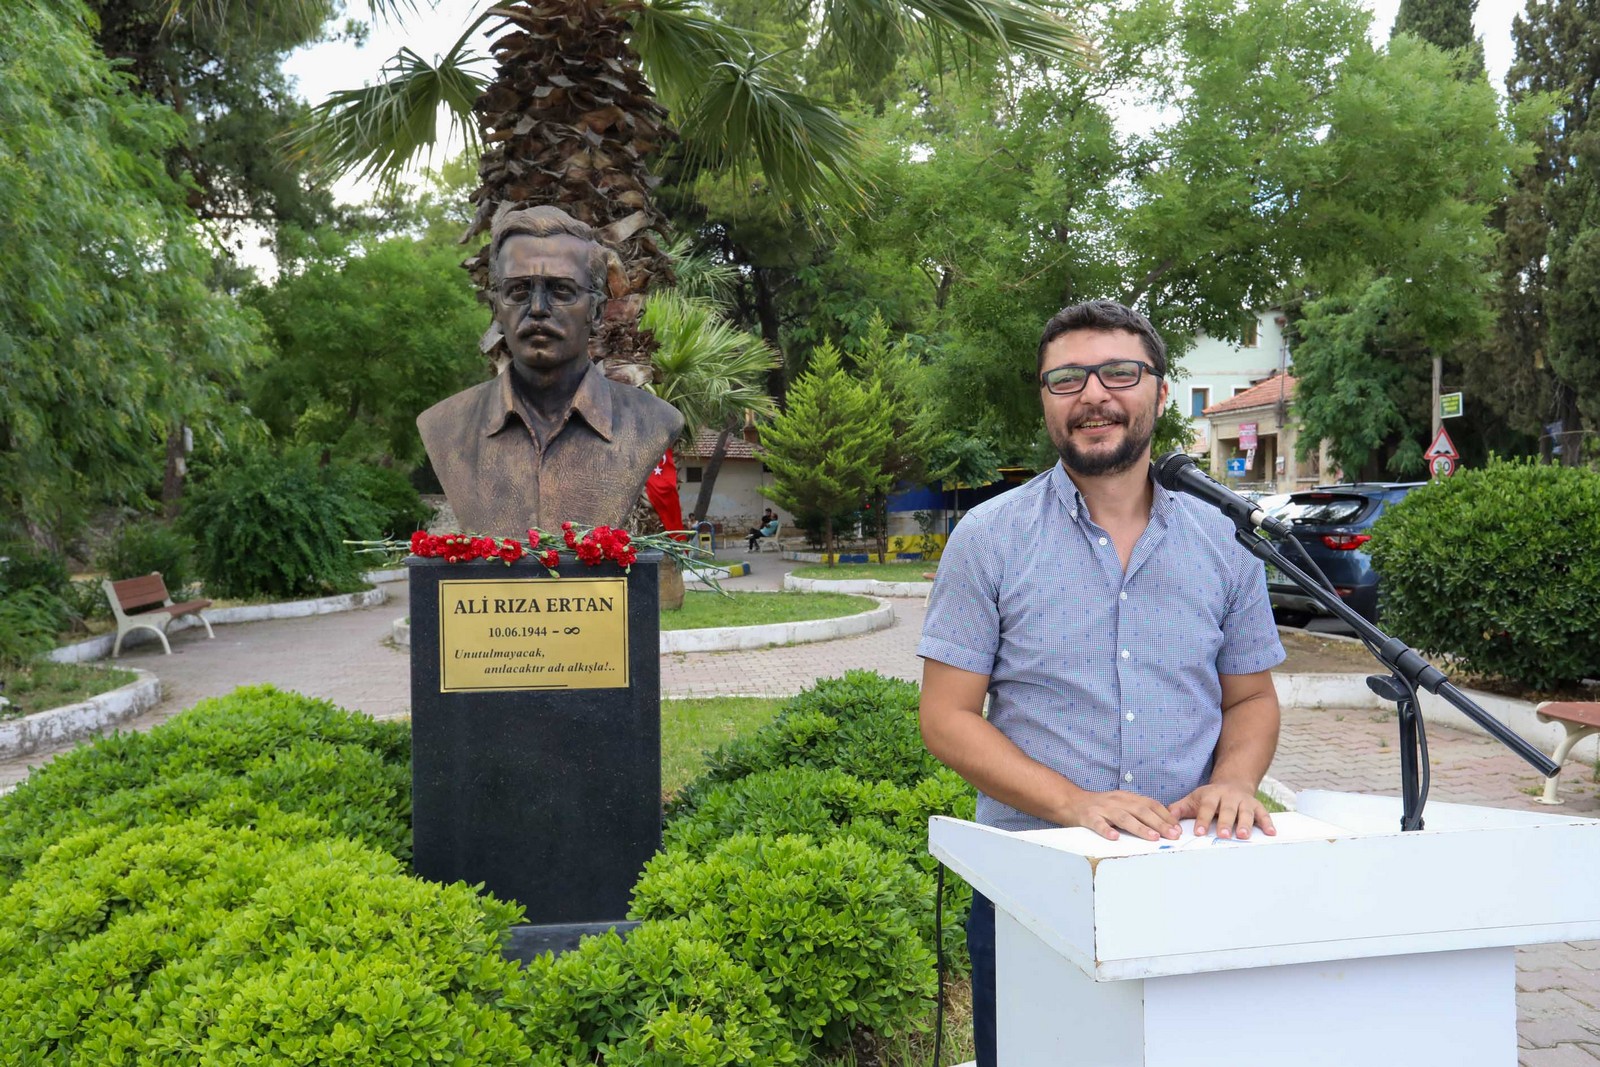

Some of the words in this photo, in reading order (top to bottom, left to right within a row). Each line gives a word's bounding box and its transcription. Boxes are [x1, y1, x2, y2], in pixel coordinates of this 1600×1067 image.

[454, 595, 488, 614] ALİ
[494, 598, 541, 614] RIZA
[546, 596, 613, 613] ERTAN
[489, 626, 547, 638] 10.06.1944
[454, 647, 545, 660] Unutulmayacak,
[484, 663, 545, 675] anılacaktır
[547, 662, 565, 673] adı
[567, 661, 615, 674] alkışla!..
